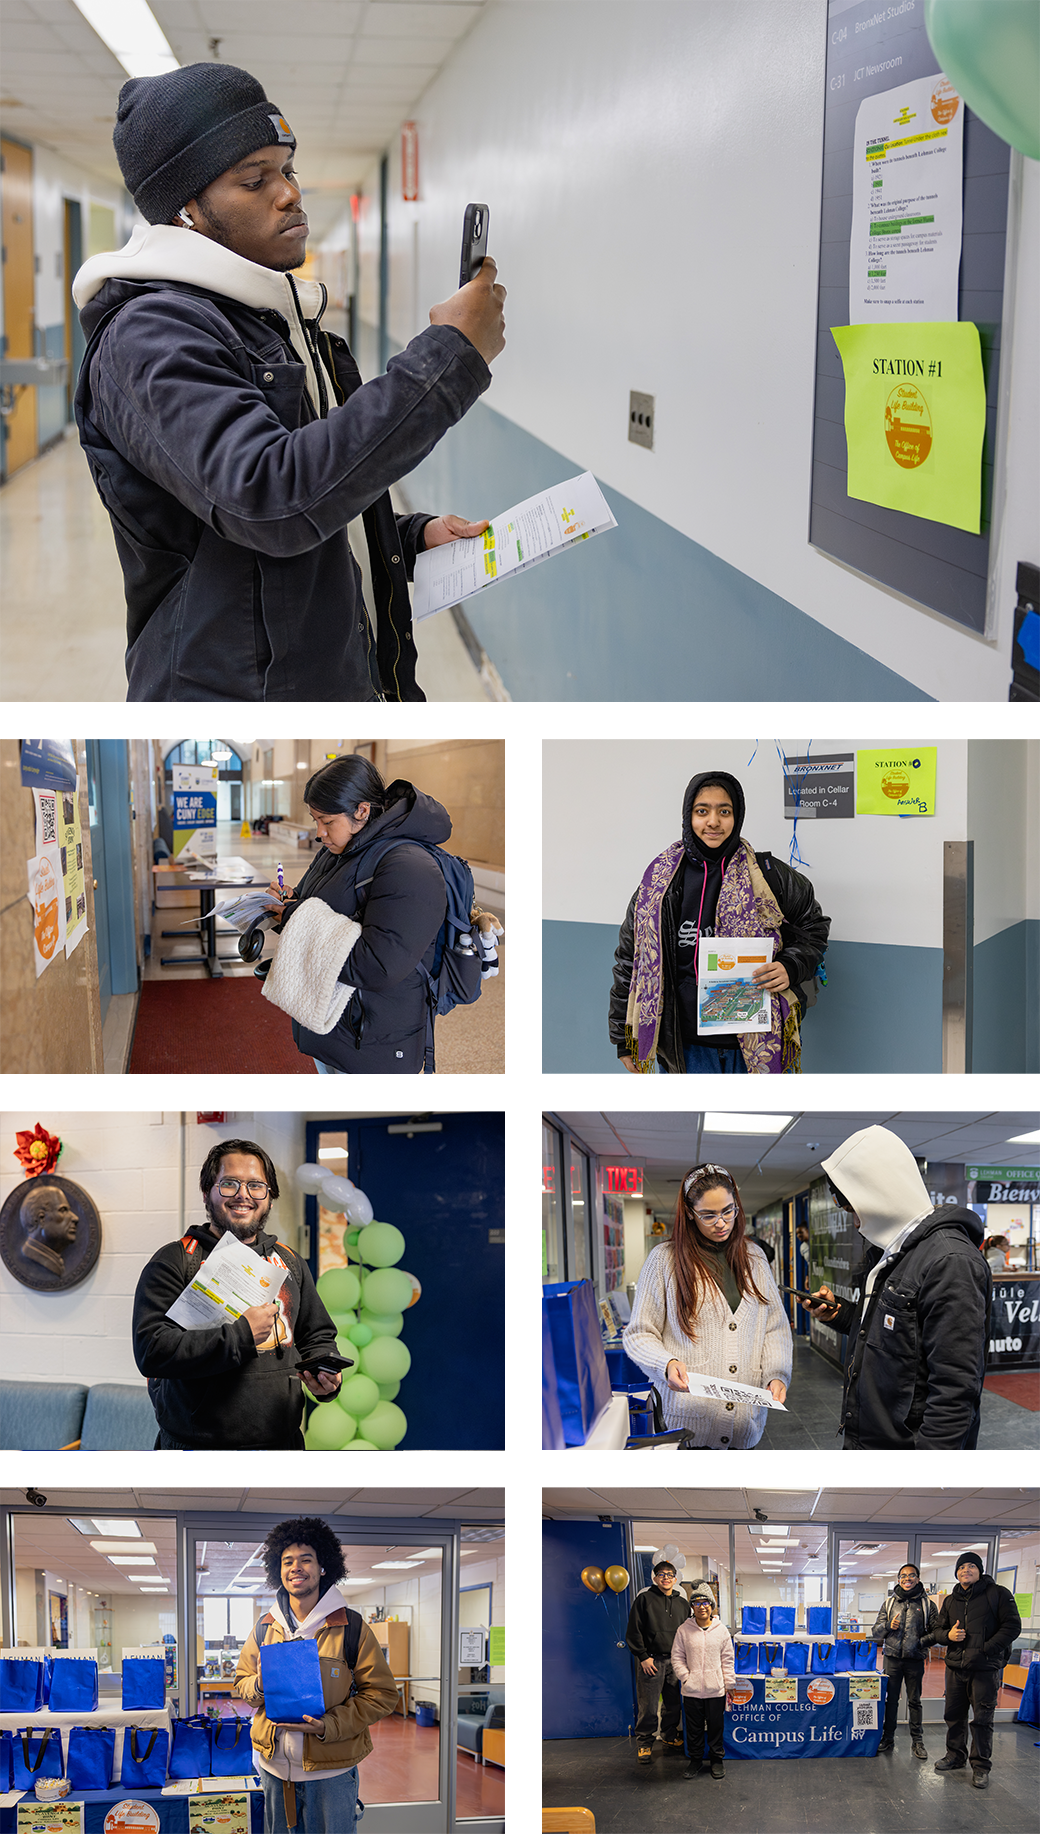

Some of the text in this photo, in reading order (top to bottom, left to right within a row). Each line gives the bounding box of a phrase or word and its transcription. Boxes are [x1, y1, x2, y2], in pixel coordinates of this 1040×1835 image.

[832, 0, 915, 44] C-04 BronxNet Studios
[830, 74, 845, 90] C-31
[866, 56, 902, 77] Newsroom
[872, 358, 942, 377] STATION #1
[897, 388, 918, 399] Student
[891, 400, 924, 417] Life Building
[176, 797, 203, 808] WE ARE
[918, 802, 927, 812] B
[176, 808, 215, 820] CUNY EDGE
[1004, 1300, 1040, 1323] Vel
[776, 1703, 817, 1712] COLLEGE
[732, 1725, 843, 1747] Campus Life
[126, 1811, 150, 1820] Building
